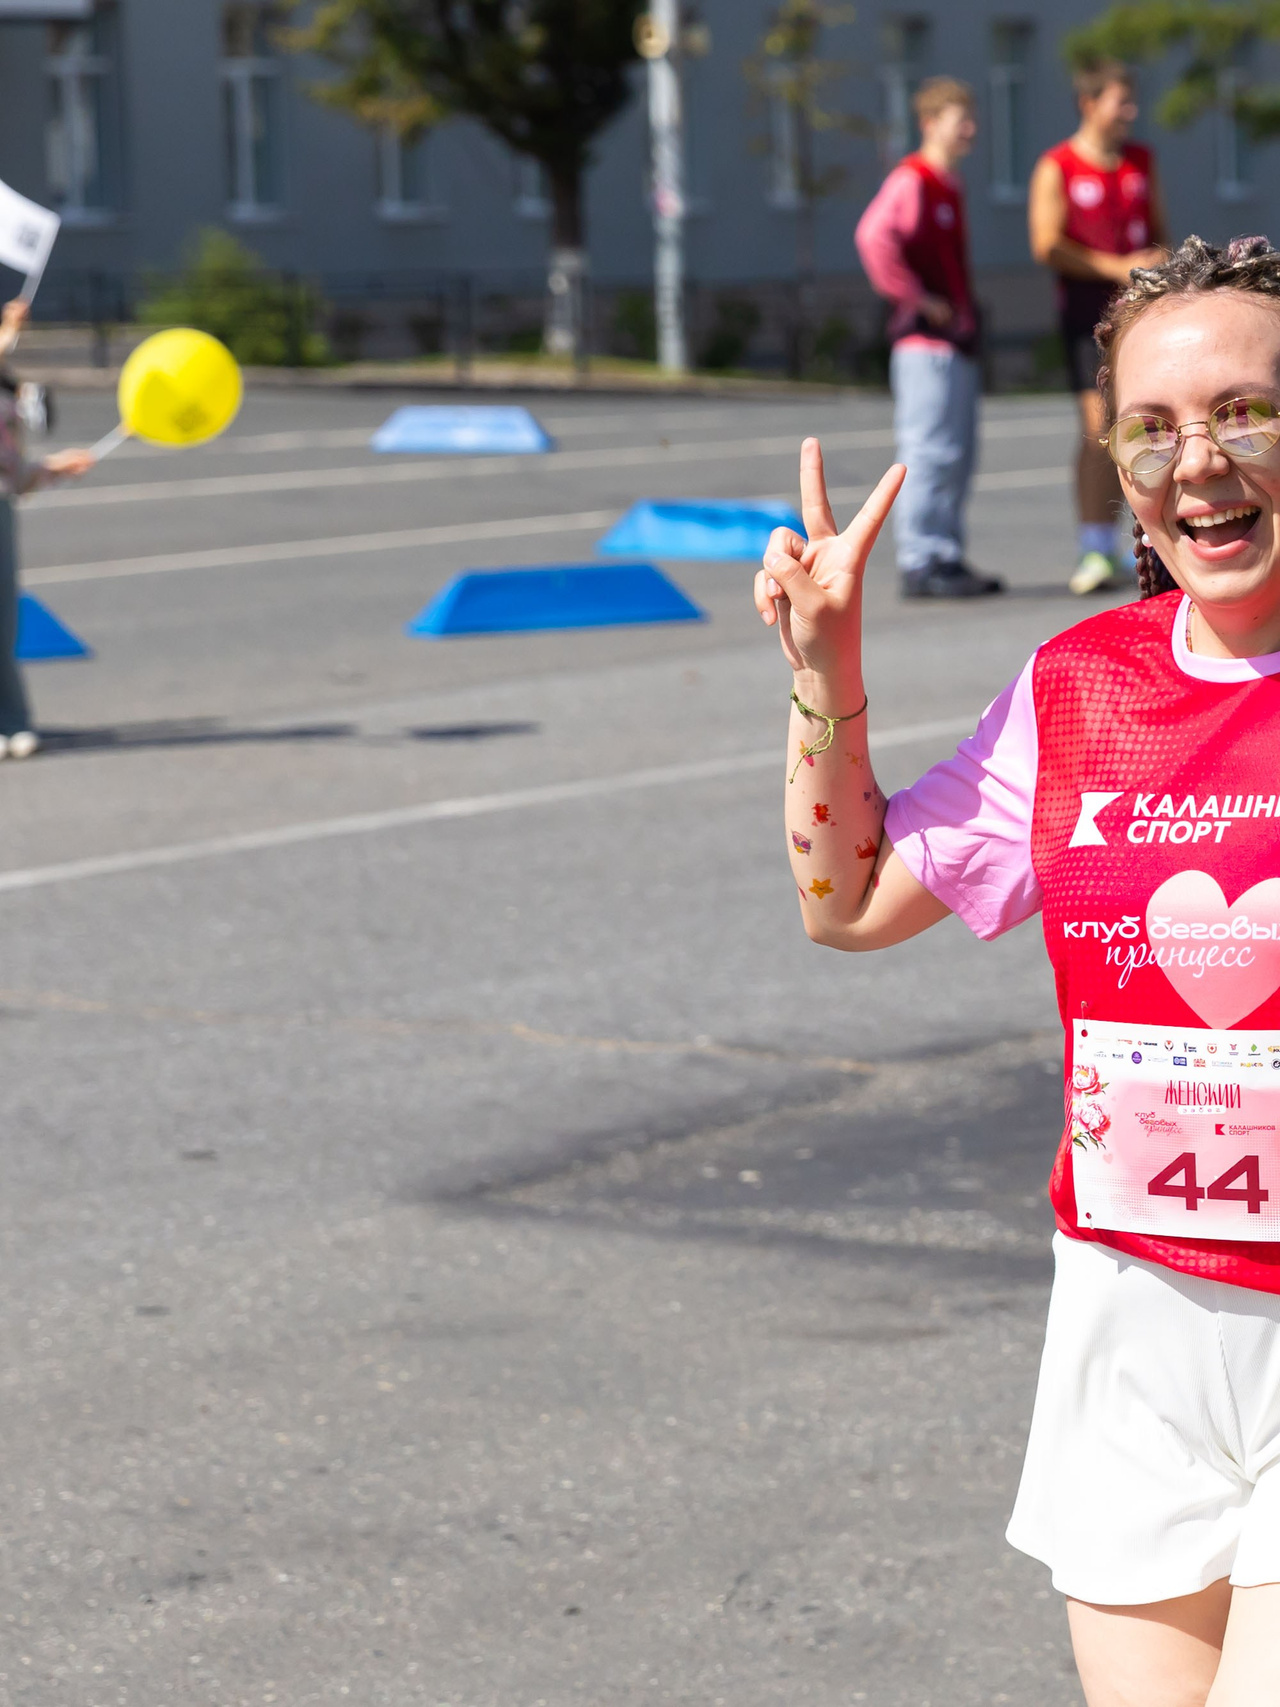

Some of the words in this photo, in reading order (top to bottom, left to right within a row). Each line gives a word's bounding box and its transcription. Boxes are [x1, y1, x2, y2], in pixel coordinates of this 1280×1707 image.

[1127, 820, 1232, 844] СПОРТ
[1063, 916, 1141, 944] клуб
[1105, 940, 1256, 989] принцесс
[1165, 1079, 1241, 1109] ЖЕНСКИЙ
[1134, 1111, 1156, 1120] клуб
[1139, 1118, 1177, 1127] беговых
[1147, 1152, 1269, 1214] 44
